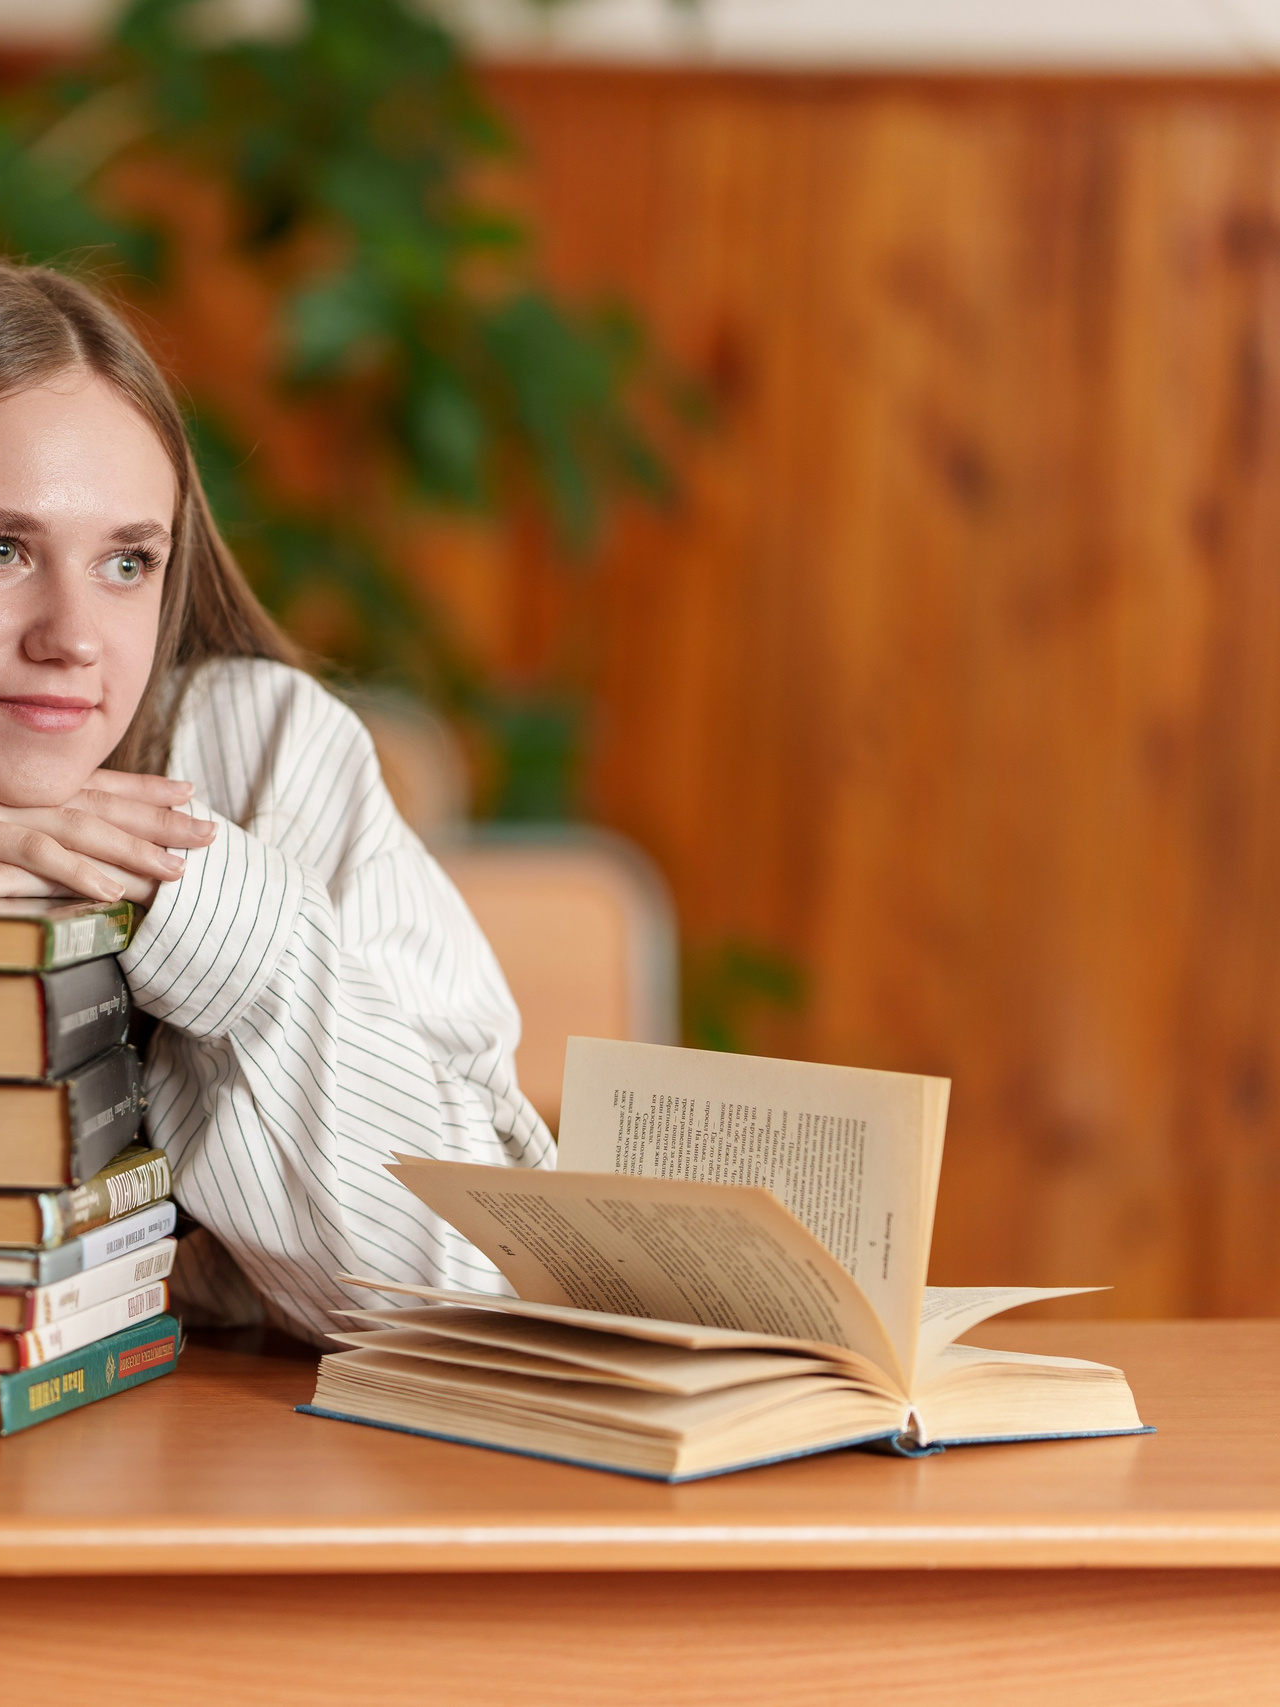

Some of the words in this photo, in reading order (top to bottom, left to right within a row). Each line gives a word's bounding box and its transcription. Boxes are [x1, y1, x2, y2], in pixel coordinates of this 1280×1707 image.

[652, 1094, 657, 1104] ки
[664, 1095, 673, 1132] обратном
[702, 1100, 711, 1132] спросил
[695, 1129, 701, 1141] На
[747, 1121, 756, 1153] круглой
[764, 1108, 772, 1144] говорили
[632, 1140, 637, 1151] он
[756, 1127, 764, 1152] Рядом
[614, 1144, 622, 1168] рукой
[670, 1150, 674, 1158] за
[723, 1167, 728, 1177] он
[105, 1163, 151, 1219] ЛЕРМОНТОВ
[106, 1237, 125, 1254] ОНЕГИН
[125, 1227, 145, 1249] ЕВГЕНИЙ
[141, 1342, 174, 1363] БИБЛИОТЕКА
[62, 1367, 85, 1394] Иван
[28, 1376, 61, 1412] БУНИН
